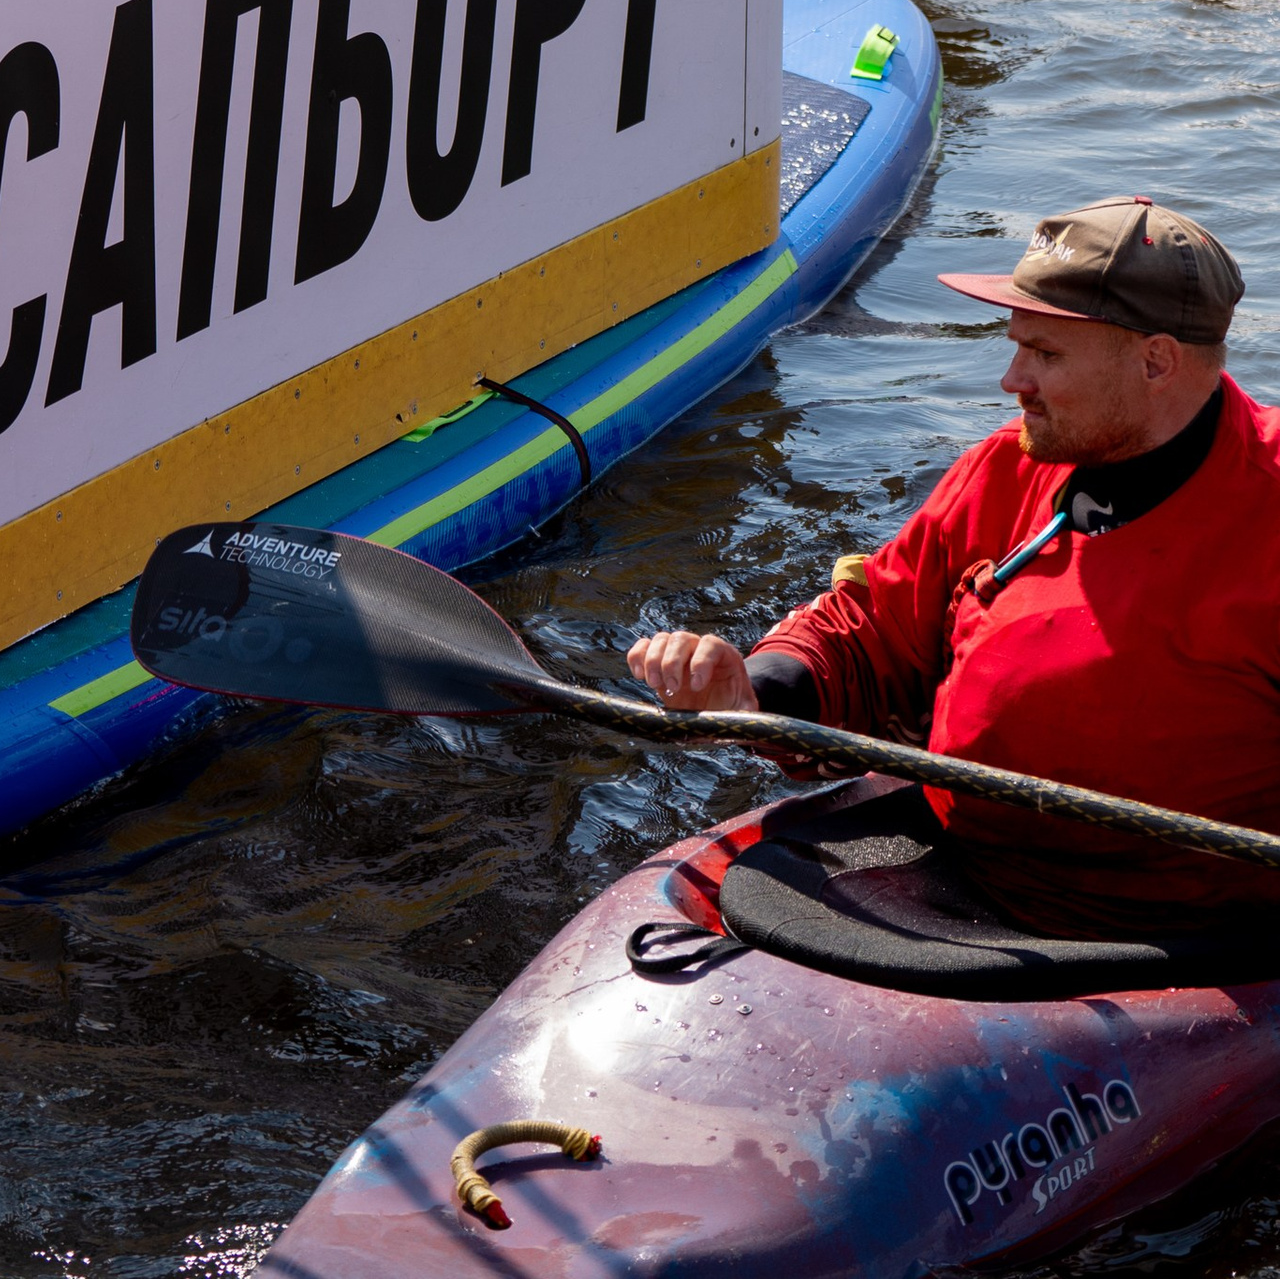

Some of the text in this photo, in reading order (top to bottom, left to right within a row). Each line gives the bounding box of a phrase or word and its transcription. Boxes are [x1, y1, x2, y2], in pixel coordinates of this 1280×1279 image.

[220, 545, 332, 580] TECHNOLOGY
[225, 532, 342, 567] ADVENTURE
[944, 1079, 1141, 1226] pyranha
